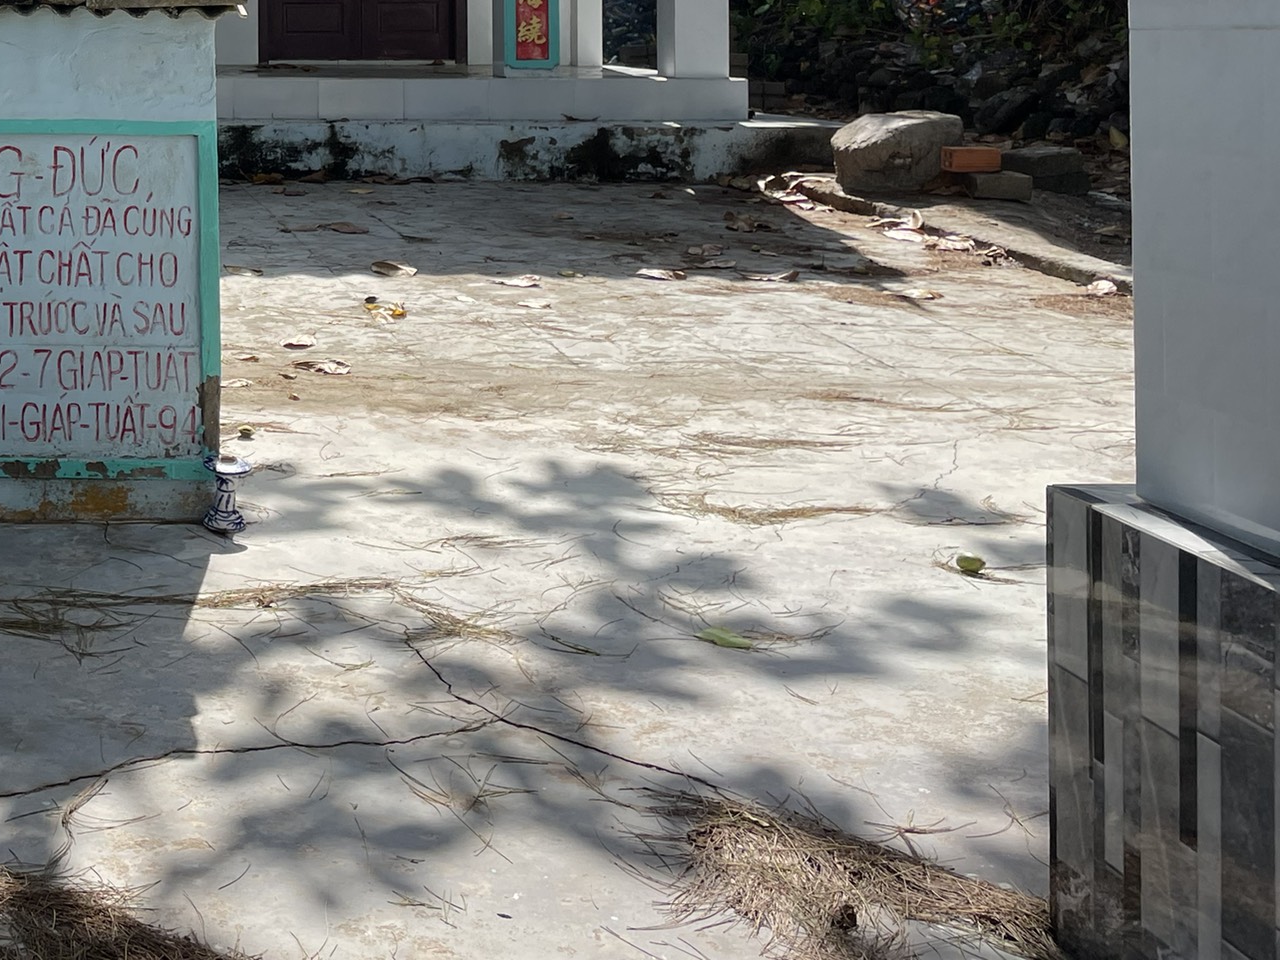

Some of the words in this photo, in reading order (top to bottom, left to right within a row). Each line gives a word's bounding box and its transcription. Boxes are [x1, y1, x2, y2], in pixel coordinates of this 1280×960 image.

[81, 198, 118, 237] ĐÃ
[122, 191, 193, 239] CÚNG
[37, 238, 111, 288] CHẤT
[116, 251, 179, 288] CHO
[94, 292, 128, 338] VÀ
[131, 300, 186, 337] SAU
